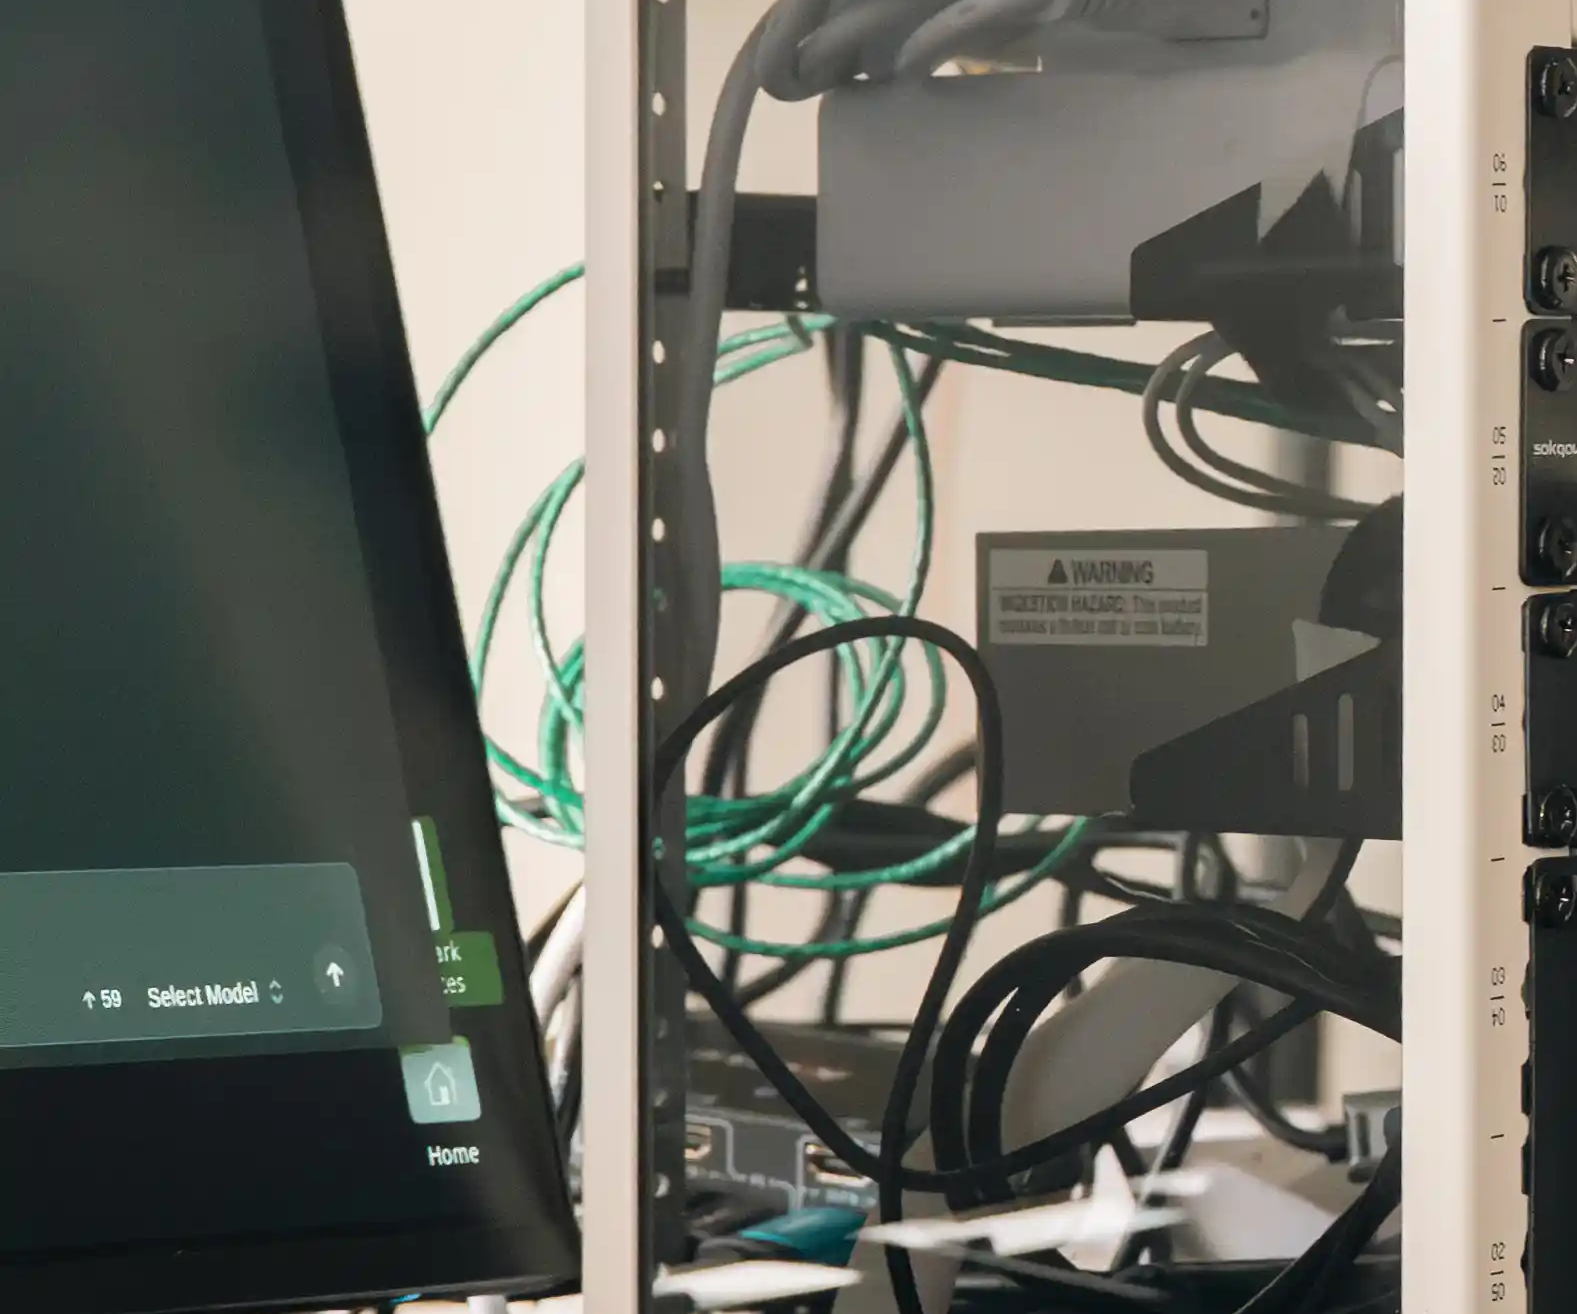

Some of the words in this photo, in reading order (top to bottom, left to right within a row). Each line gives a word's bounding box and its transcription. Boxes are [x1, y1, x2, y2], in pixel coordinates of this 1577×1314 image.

[1071, 559, 1154, 586] WARNING
[100, 989, 122, 1009] 59
[147, 985, 204, 1009] Select
[205, 981, 260, 1006] Model
[428, 1143, 480, 1167] Home
